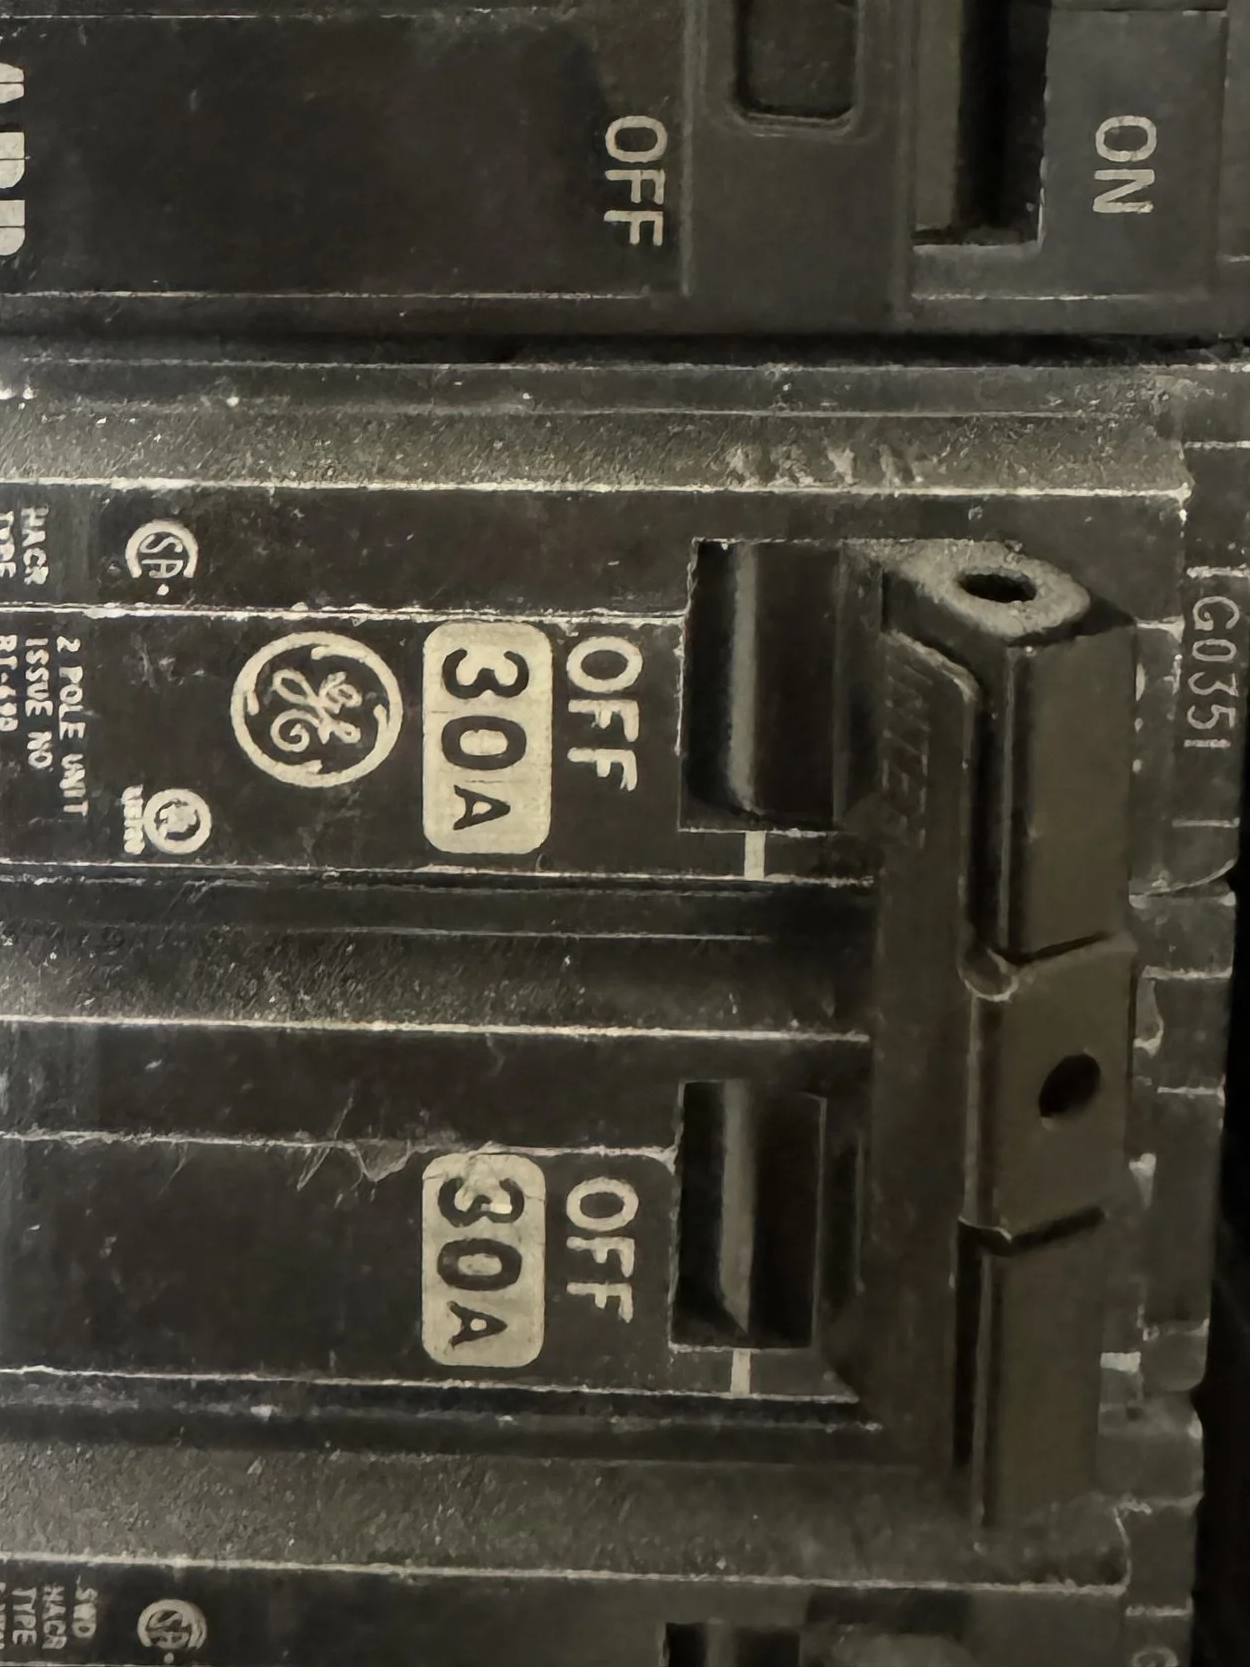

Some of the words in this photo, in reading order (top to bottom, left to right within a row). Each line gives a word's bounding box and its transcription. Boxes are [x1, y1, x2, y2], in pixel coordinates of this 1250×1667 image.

[603, 115, 668, 247] OFF
[1092, 115, 1157, 214] ON
[21, 505, 49, 586] HACR
[25, 637, 53, 716] ISSUE
[57, 636, 81, 653] 2
[59, 666, 86, 741] POLE
[440, 648, 530, 832] 30A
[566, 636, 643, 792] OFF
[27, 732, 53, 770] NO
[60, 754, 89, 817] UNIT
[436, 1177, 525, 1352] 30A
[566, 1177, 639, 1324] OFF
[11, 1587, 38, 1647] TYPE
